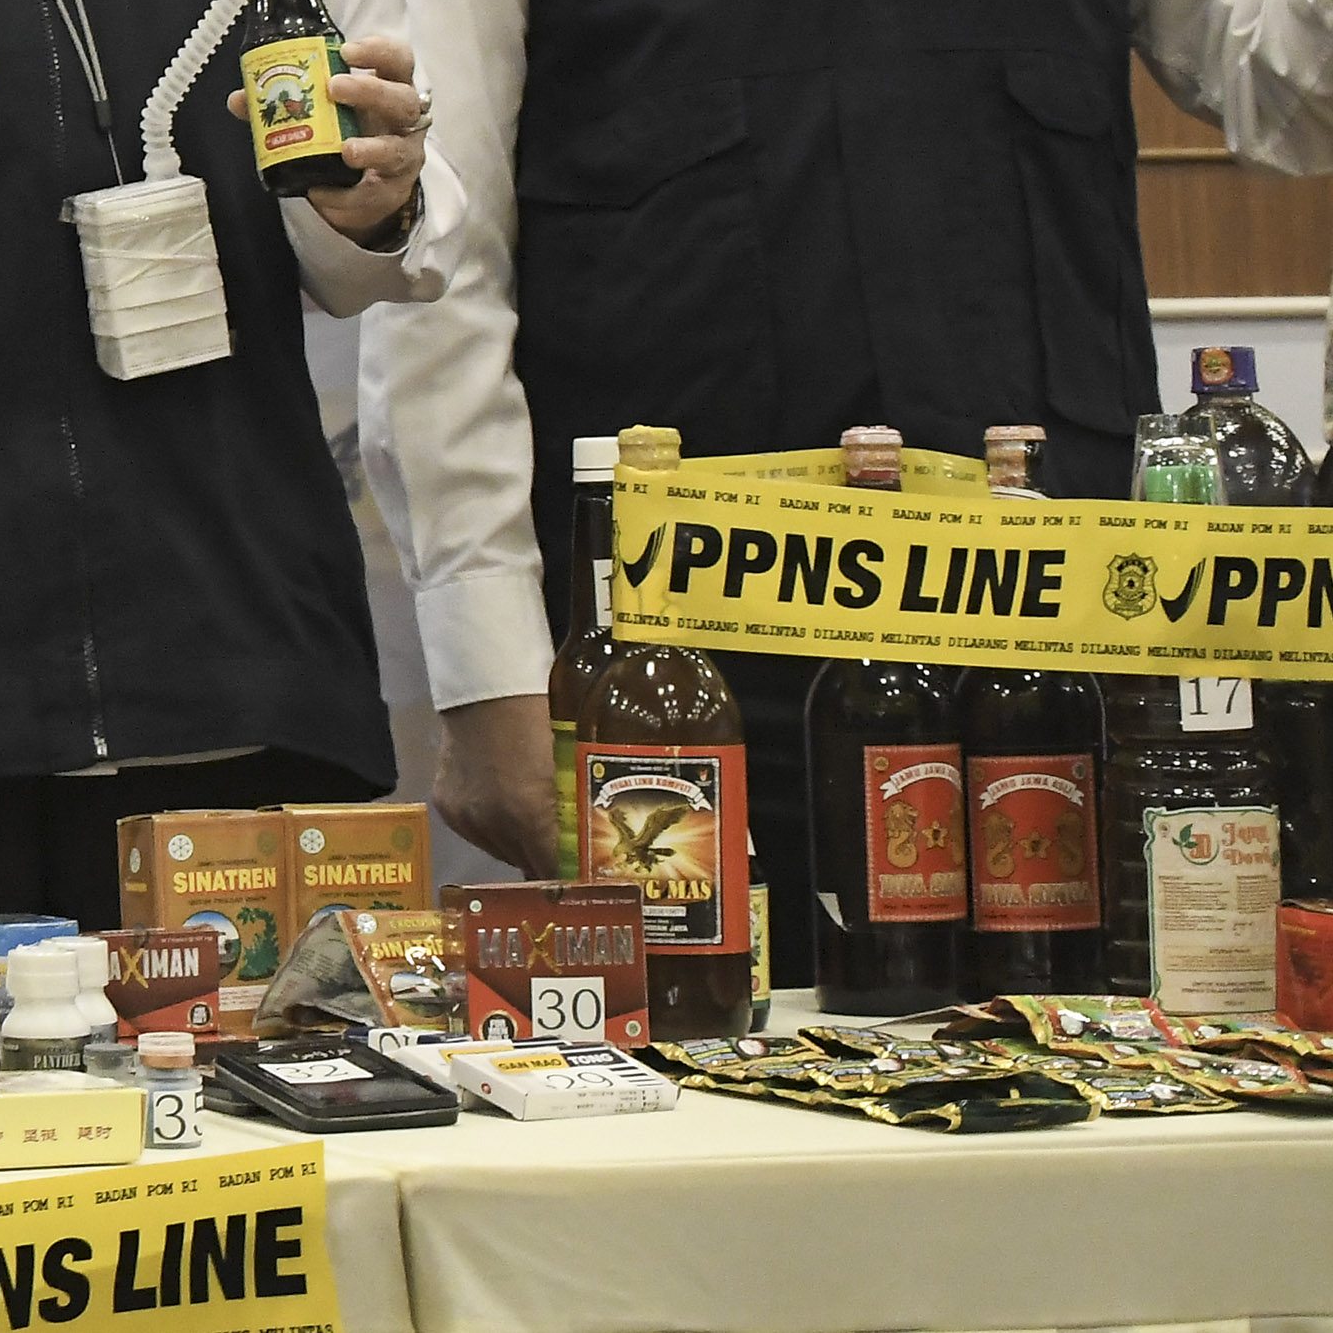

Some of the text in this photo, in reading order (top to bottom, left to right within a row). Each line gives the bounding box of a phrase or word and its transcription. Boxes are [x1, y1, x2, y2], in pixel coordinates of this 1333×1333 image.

[667, 487, 706, 499] BADAN
[715, 491, 738, 503] POM
[745, 494, 761, 505] RI
[780, 498, 819, 510] BADAN
[828, 503, 851, 514] POM
[858, 506, 873, 516] RI
[892, 509, 931, 521] BADAN
[939, 512, 962, 524] POM
[969, 514, 983, 525] RI
[1001, 515, 1036, 526] BADAN
[1043, 516, 1063, 526] POM
[1069, 516, 1081, 526] RI
[1099, 517, 1136, 528] BADAN
[1144, 518, 1167, 529] POM
[1174, 520, 1188, 530] RI
[1207, 521, 1245, 533] BADAN
[1251, 523, 1273, 534] POM
[1279, 523, 1292, 534] RI
[669, 522, 885, 610] PPNS
[900, 544, 1067, 618] LINE
[677, 618, 739, 633] DILARANG
[745, 624, 806, 638] MELINTAS
[814, 628, 874, 642] DILARANG
[881, 633, 941, 646] MELINTAS
[948, 637, 1008, 650] DILARANG
[1014, 640, 1073, 653] MELINTAS
[1081, 643, 1140, 656] DILARANG
[1147, 646, 1207, 659] MELINTAS
[1212, 648, 1273, 661] DILARANG
[1188, 676, 1244, 715] 17
[173, 867, 277, 895] SINATREN
[303, 862, 413, 887] SINATREN
[668, 879, 713, 901] MAS
[477, 920, 636, 974] MAXIMAN
[536, 988, 602, 1031] 30
[566, 1052, 613, 1065] TONG
[22, 1198, 49, 1213] POM
[57, 1195, 74, 1209] RI
[95, 1186, 138, 1204] BADAN
[147, 1183, 173, 1197] POM
[181, 1179, 198, 1193] RI
[219, 1171, 261, 1188] BADAN
[269, 1166, 294, 1181] POM
[301, 1162, 317, 1176] RI
[112, 1205, 309, 1314] LINE
